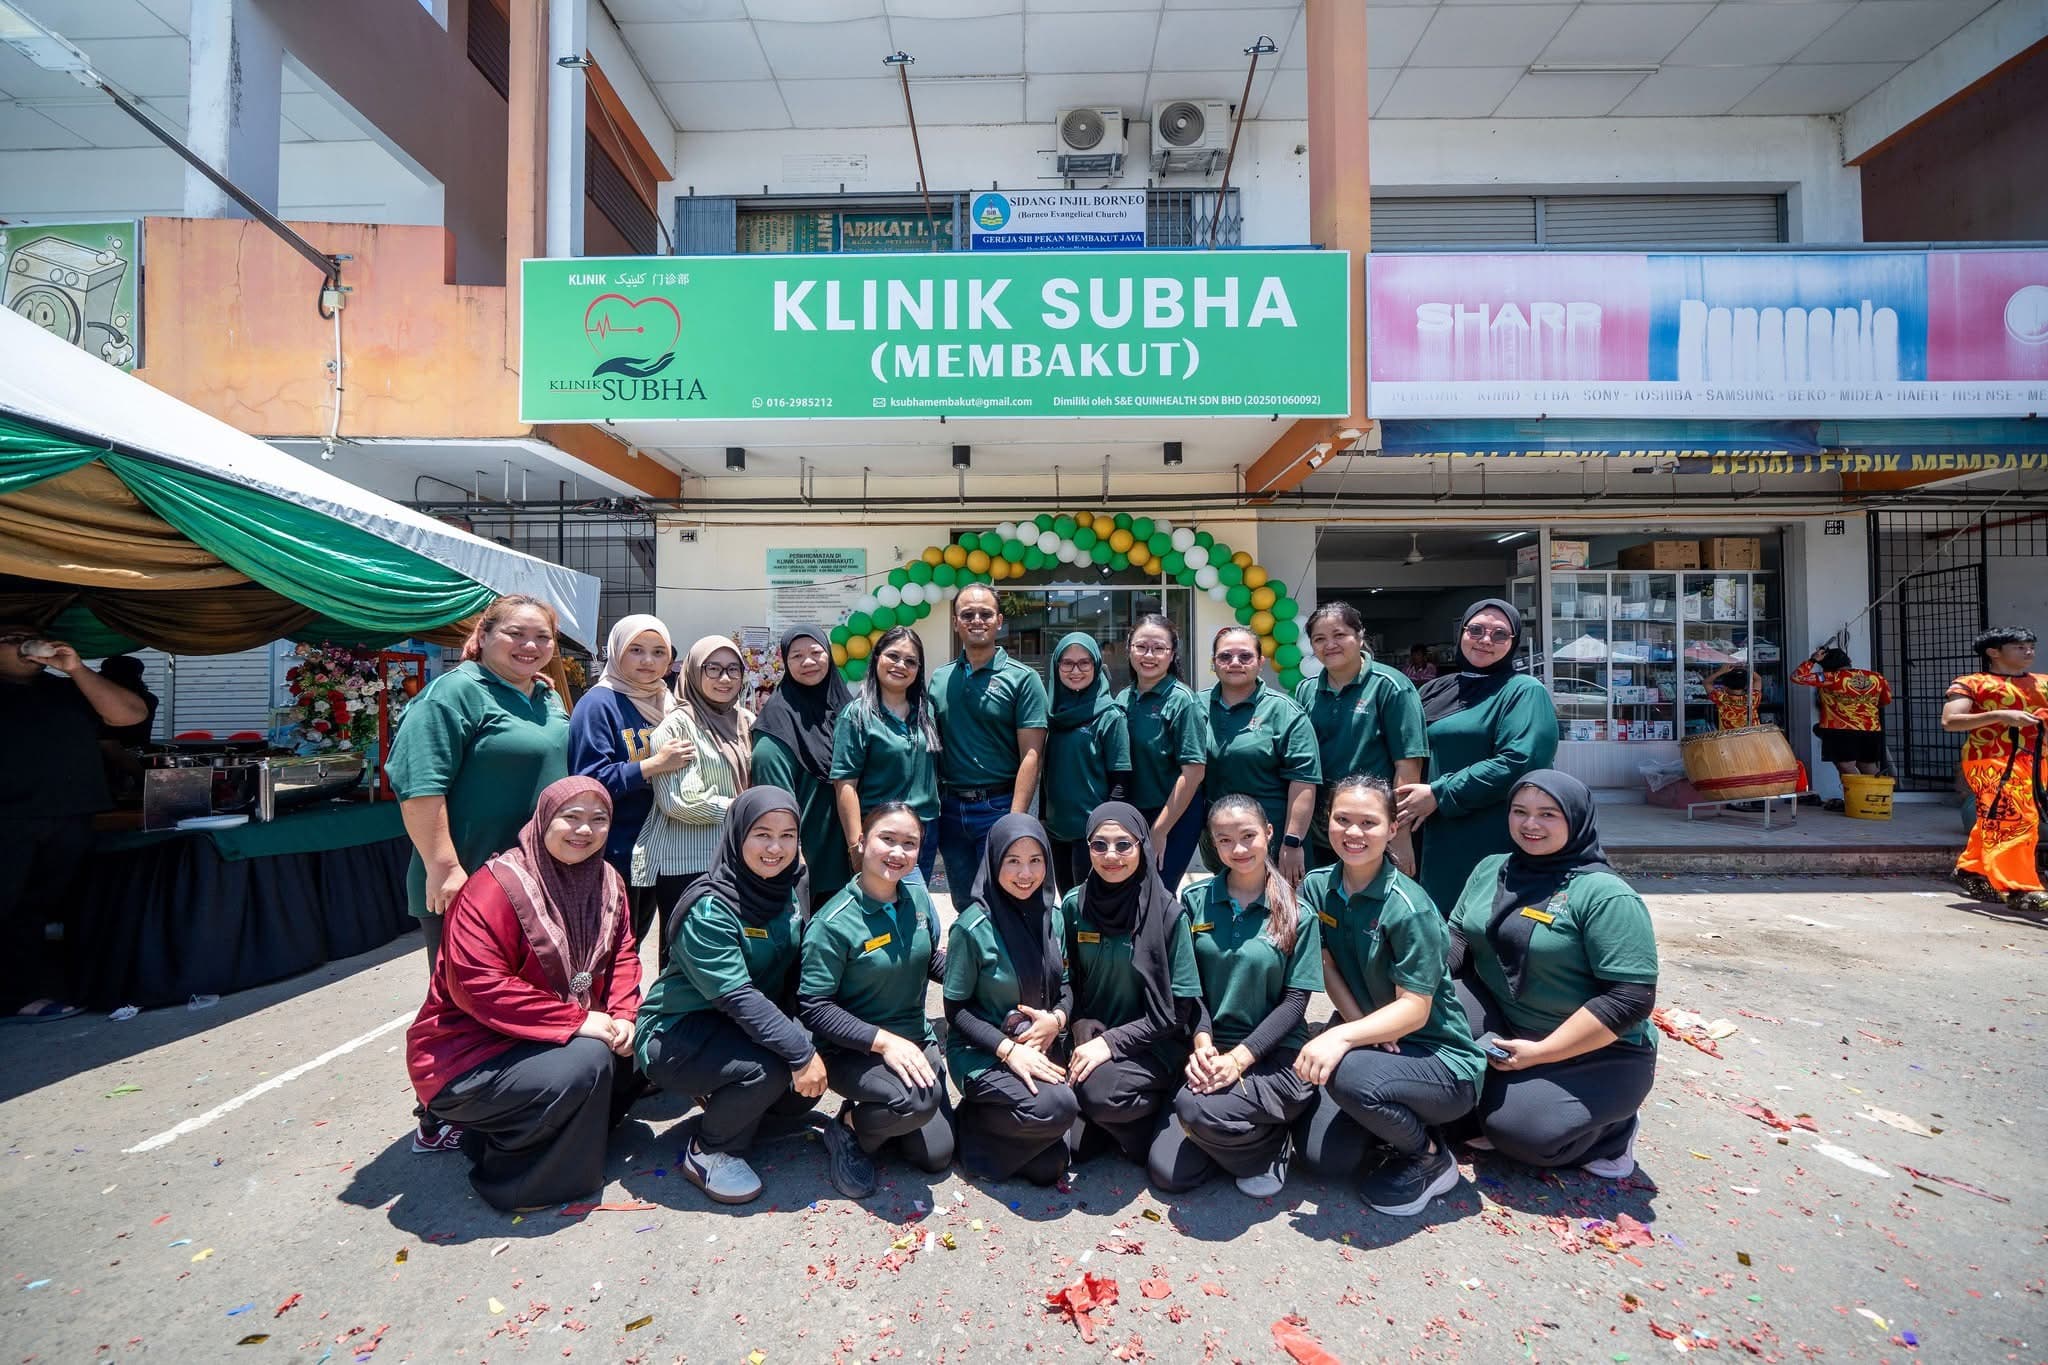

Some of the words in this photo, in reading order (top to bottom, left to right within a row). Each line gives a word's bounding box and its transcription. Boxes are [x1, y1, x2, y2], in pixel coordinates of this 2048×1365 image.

[1010, 196, 1056, 207] SIDANG
[1059, 196, 1091, 206] INJIL
[1093, 195, 1145, 206] BORNEO
[1017, 211, 1049, 219] (Borneo
[1050, 210, 1094, 220] Evangelical
[1095, 210, 1128, 219] Church)
[982, 235, 1017, 243] GEREJA
[1018, 235, 1033, 243] SIB
[1034, 234, 1065, 243] PEKAN
[1066, 234, 1118, 242] MEMBAKUT
[1119, 234, 1142, 242] JAYA
[568, 274, 607, 286] KLINIK
[652, 272, 690, 286] 门诊部
[773, 279, 1013, 331] KLINIK
[1041, 276, 1298, 329] SUBHA
[1416, 302, 1602, 329] SHARP
[871, 337, 1200, 383] (MEMBAKUT)
[550, 380, 601, 390] KLINIK
[602, 378, 708, 401] SUBHA
[1583, 389, 1620, 401] SONY
[1634, 389, 1693, 401] TOSHIBA
[1706, 389, 1774, 401] SAMSUNG
[1839, 389, 1883, 401] MIDEA
[766, 398, 833, 408] 016-2985212
[890, 396, 1033, 408] ksubhamembakut@gmail.com
[1053, 396, 1090, 406] Dimiliki
[1091, 396, 1113, 406] oleh
[1114, 396, 1134, 406] S&E
[1134, 395, 1198, 406] QUINHEALTH
[1199, 395, 1220, 405] SDN
[1221, 395, 1242, 405] BHD
[1244, 394, 1321, 406] (202501060092)
